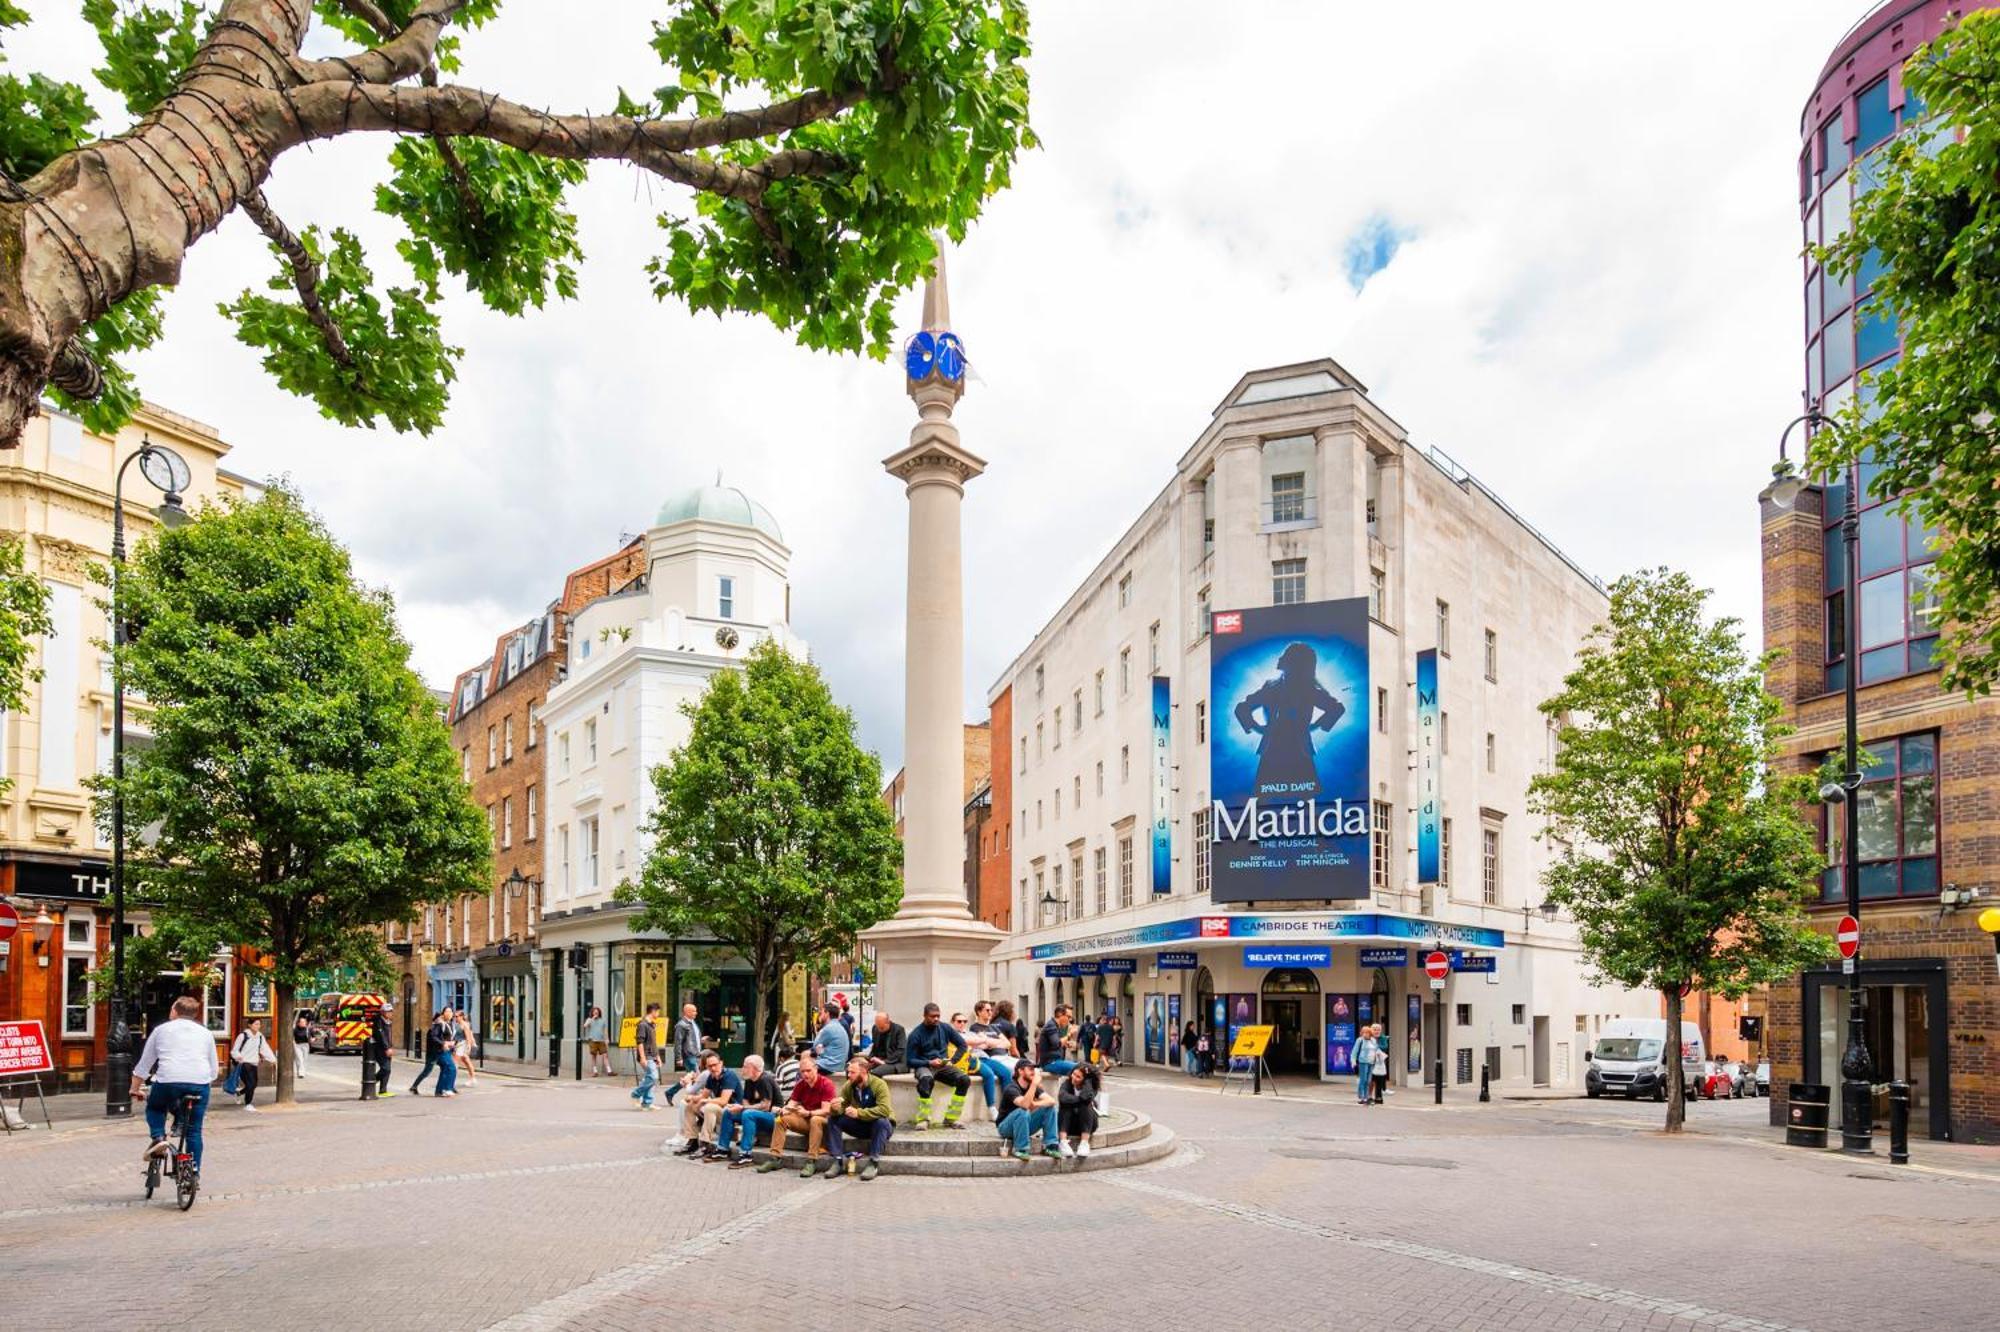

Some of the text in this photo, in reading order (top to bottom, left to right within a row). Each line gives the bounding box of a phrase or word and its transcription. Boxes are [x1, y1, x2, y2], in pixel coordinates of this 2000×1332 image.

[1419, 689, 1436, 833] Matilda
[1154, 714, 1169, 848] Matilda
[1212, 797, 1369, 843] Matilda
[1259, 839, 1319, 849] THE MUSICAL
[1229, 859, 1288, 869] DENNIS KELLY
[1242, 919, 1365, 931] CAMBRIDGE THEATRE
[1284, 953, 1301, 962] THE
